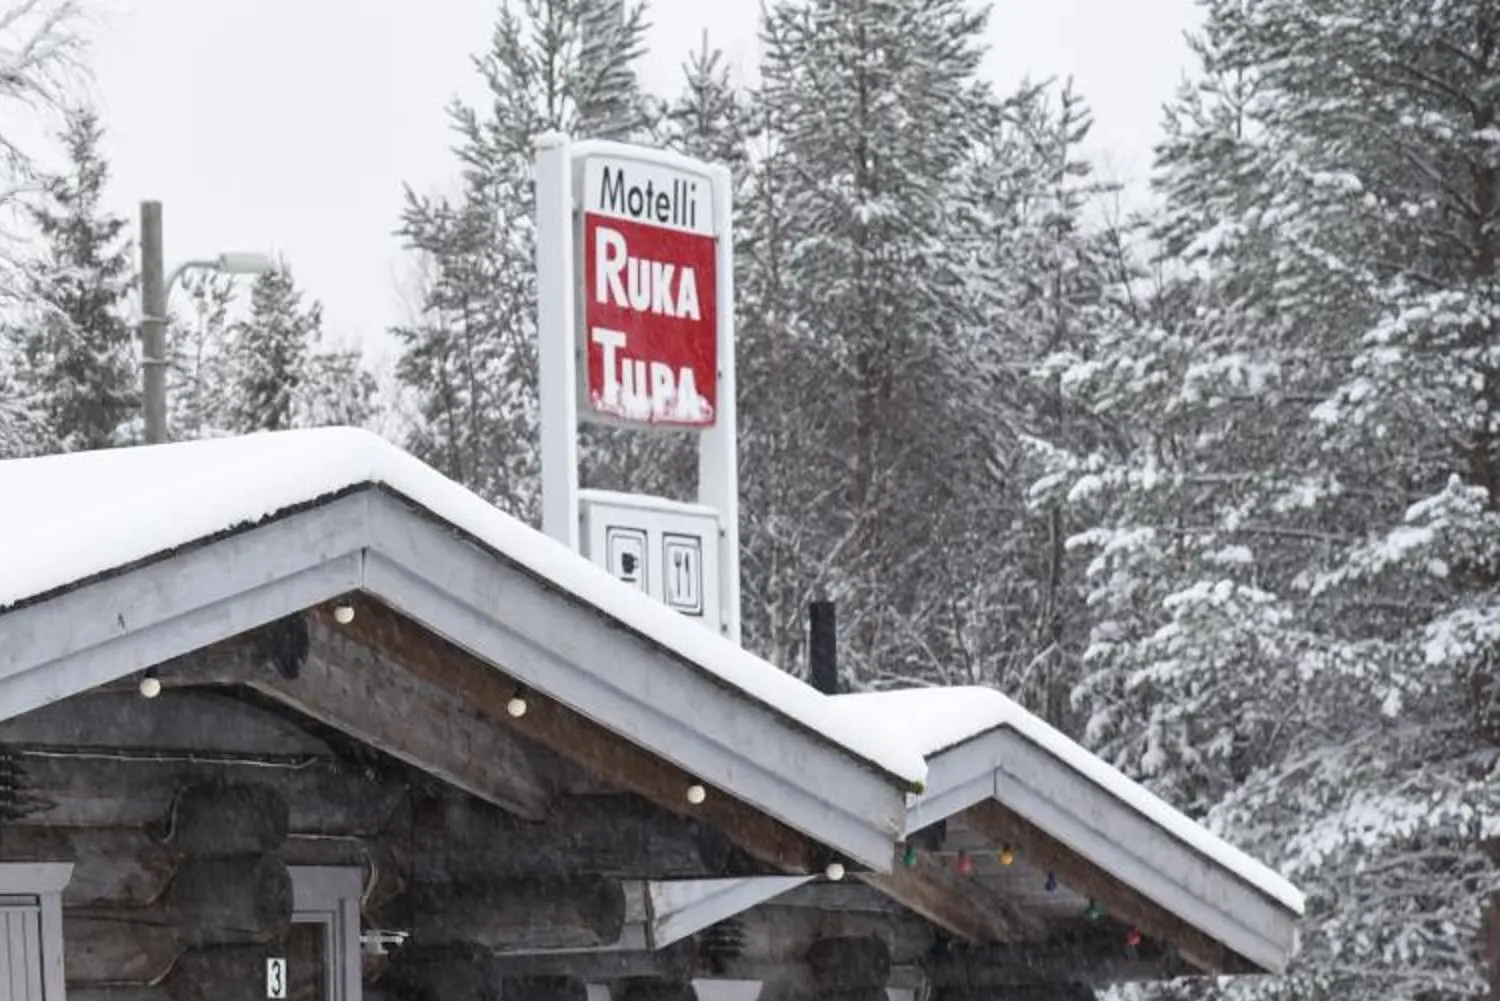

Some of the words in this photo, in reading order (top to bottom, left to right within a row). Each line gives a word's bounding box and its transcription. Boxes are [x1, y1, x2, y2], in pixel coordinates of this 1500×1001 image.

[600, 165, 697, 229] Motelli
[595, 225, 701, 321] RUKA
[591, 326, 703, 419] TUPA
[271, 960, 282, 997] 3
